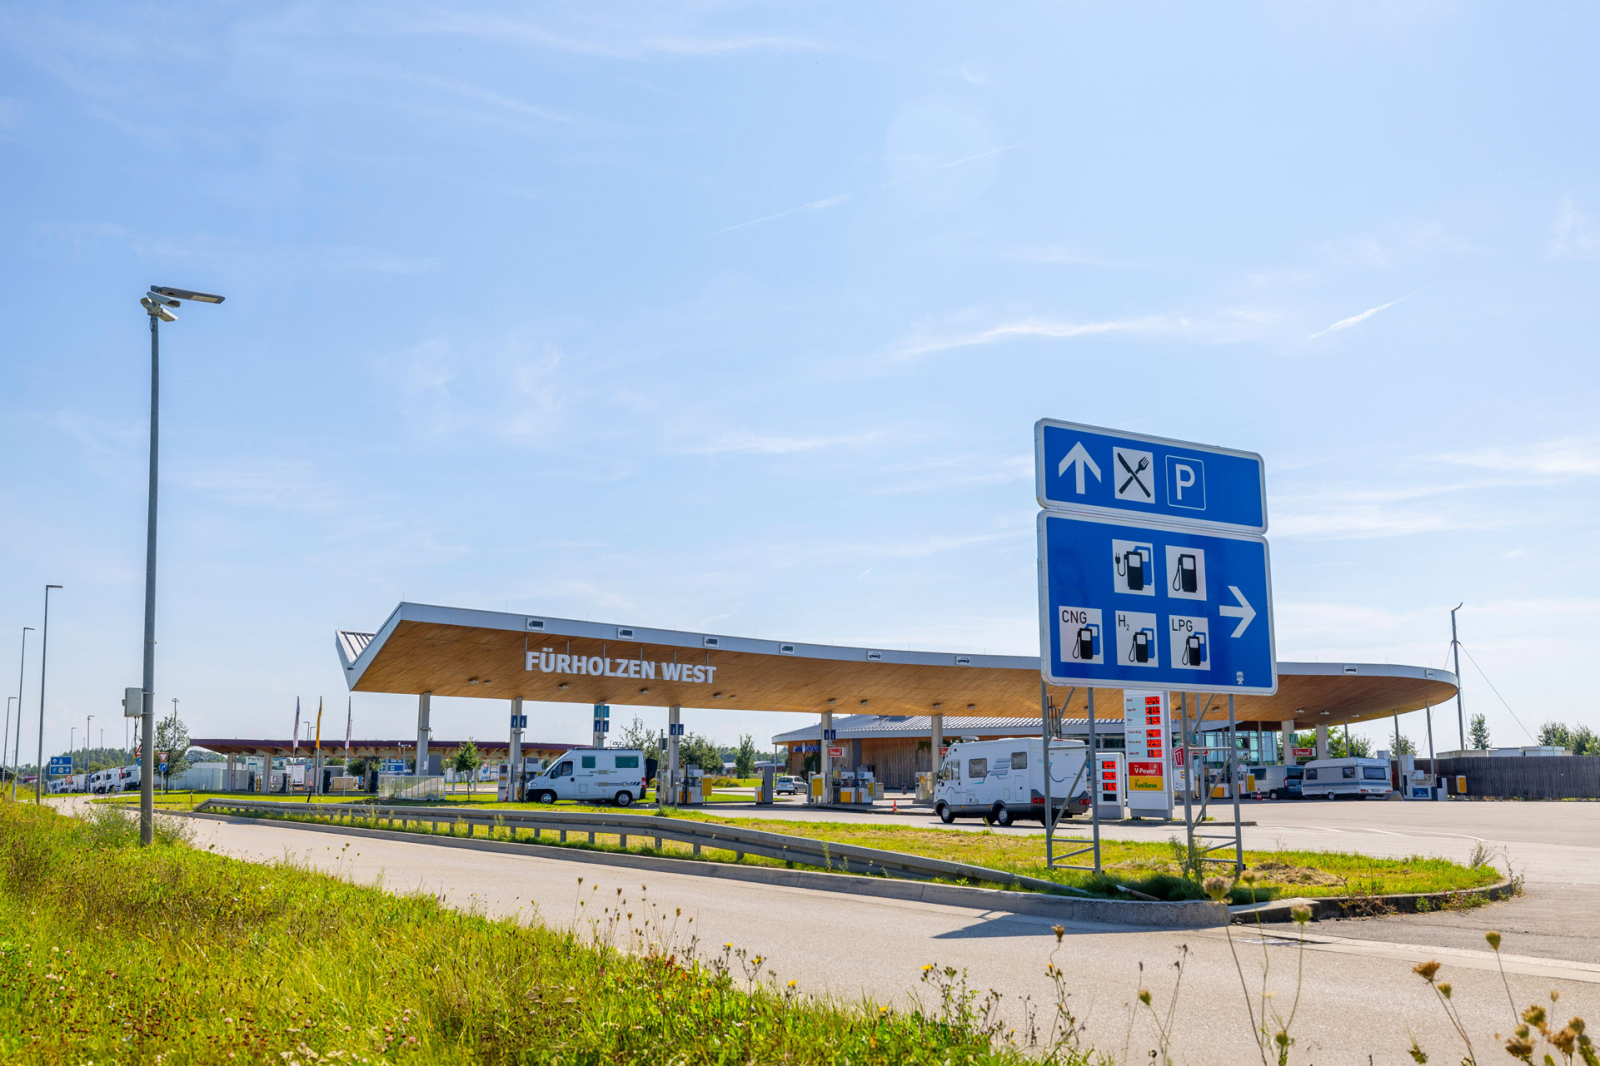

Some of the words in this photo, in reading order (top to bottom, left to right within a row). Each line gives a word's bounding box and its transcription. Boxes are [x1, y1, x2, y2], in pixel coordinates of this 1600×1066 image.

[1171, 463, 1195, 506] P
[1061, 609, 1088, 625] CNG
[1171, 617, 1193, 633] LPG
[525, 647, 656, 680] FÜRHOLZEN
[660, 661, 717, 685] WEST
[1134, 767, 1156, 775] V-Power
[1134, 781, 1158, 789] FuelSave
